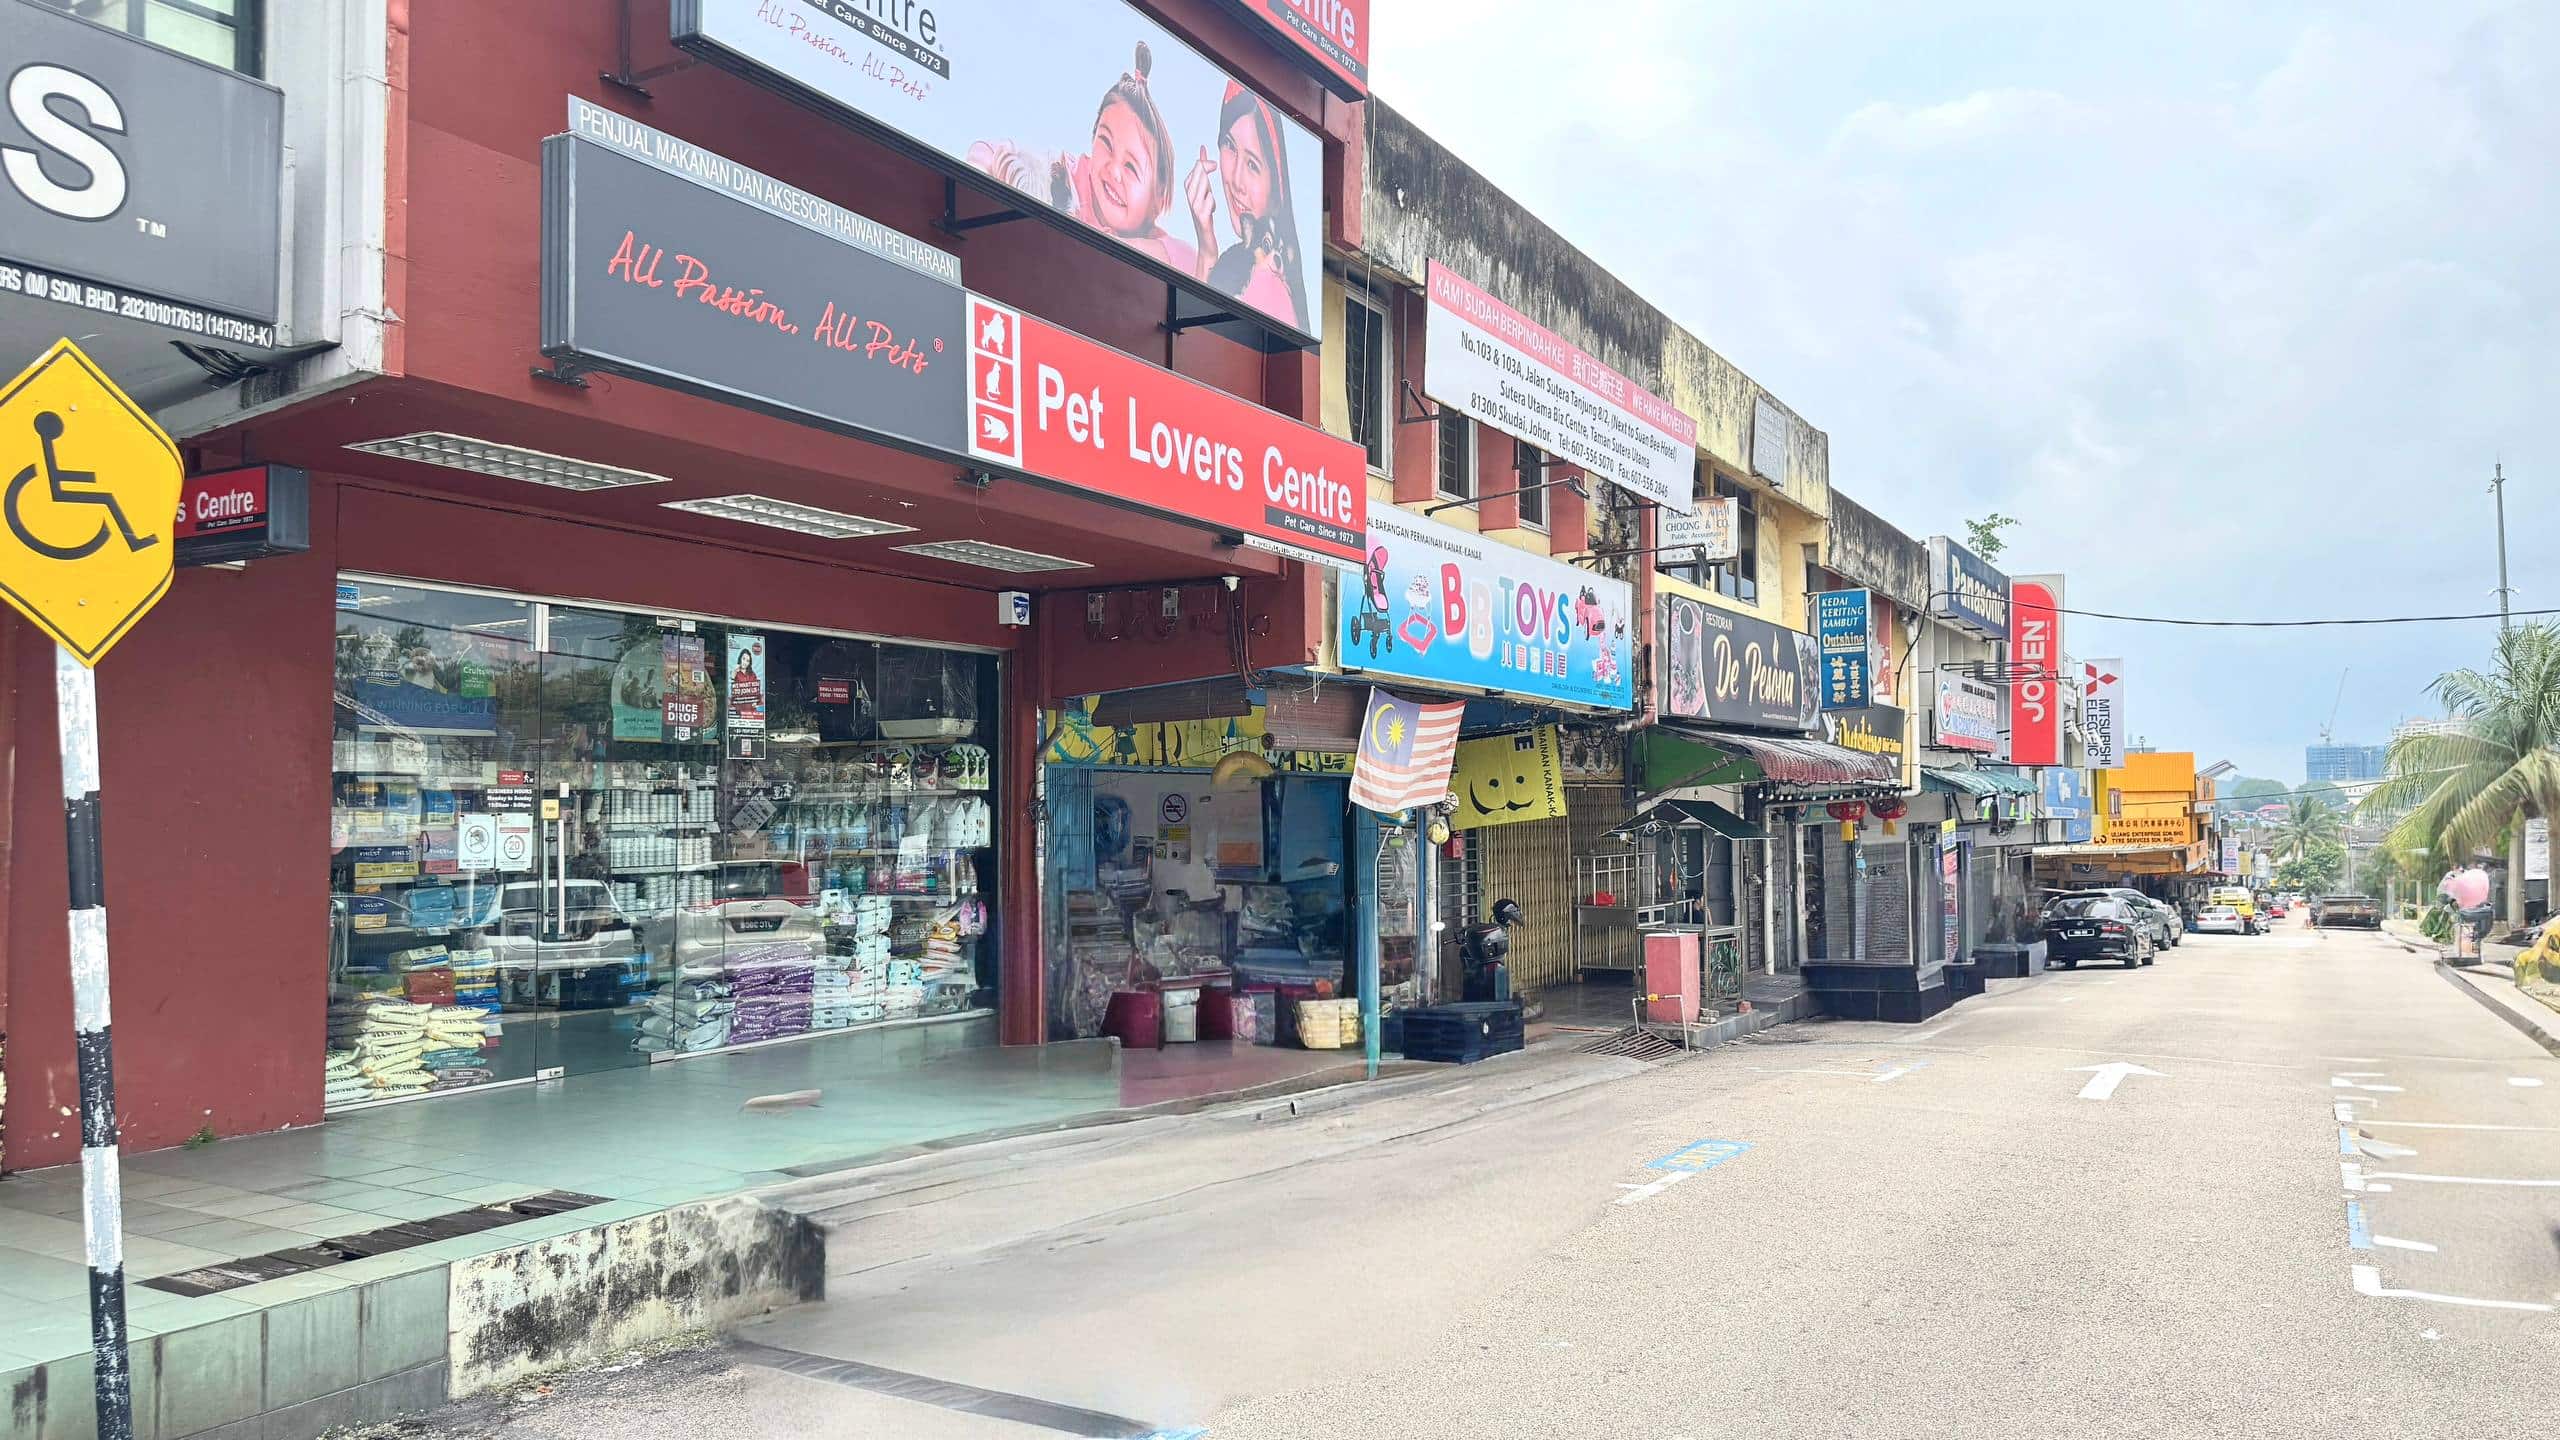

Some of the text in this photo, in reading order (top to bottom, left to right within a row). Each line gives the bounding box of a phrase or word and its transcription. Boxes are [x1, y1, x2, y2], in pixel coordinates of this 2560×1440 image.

[835, 5, 865, 29] Care
[872, 24, 907, 52] Since
[913, 48, 941, 70] 1973
[1287, 10, 1356, 72] Pet Care Since 1973
[580, 104, 954, 280] PENJUAL MAKANAN DAN AKSESORI HAIWAN PELIHARAAN
[136, 218, 167, 238] TM
[24, 270, 48, 298] (M)
[51, 278, 84, 306] SDN.
[86, 286, 118, 313] BHD.
[608, 230, 663, 288] All
[674, 254, 799, 335] Passion.
[814, 301, 857, 352] All
[1436, 273, 1464, 305] KAMI
[1465, 293, 1500, 325] SUDAH
[1501, 310, 1551, 355] BERPINDAH
[1461, 331, 1491, 361] No.103
[1494, 348, 1500, 366] &
[1526, 366, 1545, 389] Jalan
[1547, 377, 1569, 402] Sutera
[1571, 390, 1597, 421] Tanjung
[1628, 425, 1635, 440] to
[1632, 390, 1643, 411] WE
[1644, 399, 1661, 421] HAVE
[1661, 410, 1682, 434] MOVED
[1037, 362, 1352, 524] Pet Lovers Centre
[1471, 391, 1497, 418] 81300
[1571, 440, 1598, 464] 607-556
[1599, 454, 1614, 473] 5070
[1500, 380, 1525, 406] Sutera
[1527, 393, 1552, 420] Utama
[1553, 406, 1564, 425] Biz
[1590, 425, 1611, 450] Taman
[1611, 437, 1631, 459] Sutera
[1631, 447, 1650, 469] Utama
[197, 488, 254, 519] Centre
[1285, 515, 1354, 545] Pet Care Since 1973
[1665, 520, 1699, 532] CHOONG
[1376, 519, 1409, 539] BARANGAN
[1410, 529, 1442, 548] PERMAINAN
[1498, 575, 1569, 645] TOYS
[1821, 597, 1848, 607] KEDAI
[1822, 605, 1864, 618] KERITING
[1951, 554, 2006, 628] Panasonic
[1705, 612, 1733, 632] RESTORAN
[1822, 617, 1858, 629] RAMBUT
[1713, 634, 1740, 698] De
[2021, 620, 2045, 723] JOVEN
[668, 703, 698, 713] PRICE
[668, 712, 697, 722] DROP
